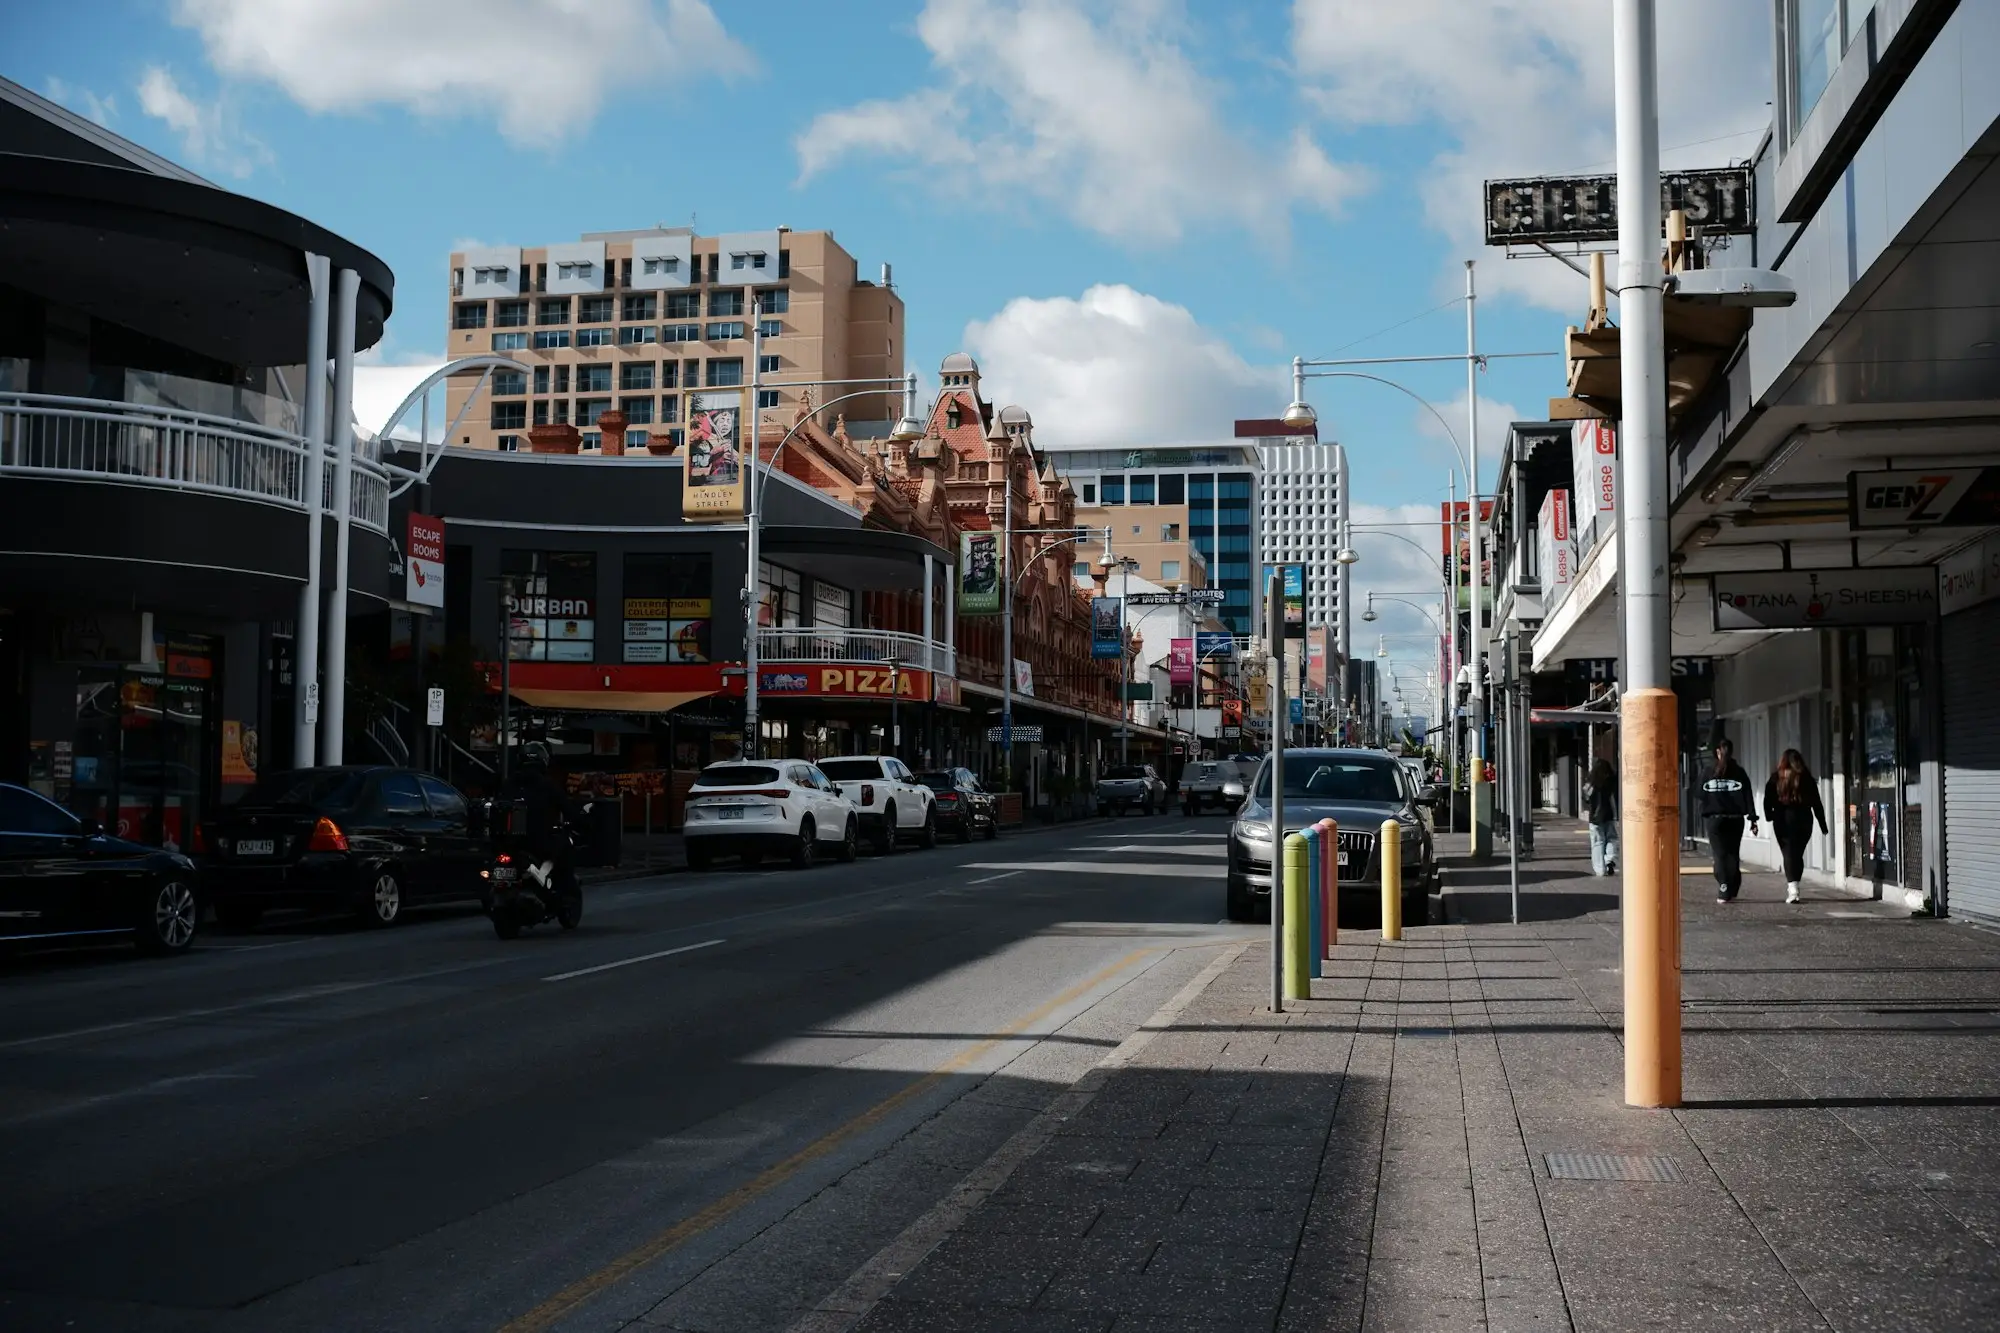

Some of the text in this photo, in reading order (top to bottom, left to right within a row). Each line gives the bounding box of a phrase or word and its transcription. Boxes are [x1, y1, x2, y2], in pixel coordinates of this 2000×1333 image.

[693, 491, 733, 499] HINDLEY
[1600, 465, 1614, 511] Lease
[412, 526, 441, 543] ESCAPE
[413, 543, 440, 559] ROOMS
[1556, 548, 1567, 583] Lease
[1719, 588, 1933, 608] ROTANA SHEESHA
[821, 669, 914, 695] PIZZA
[432, 690, 442, 699] 1P
